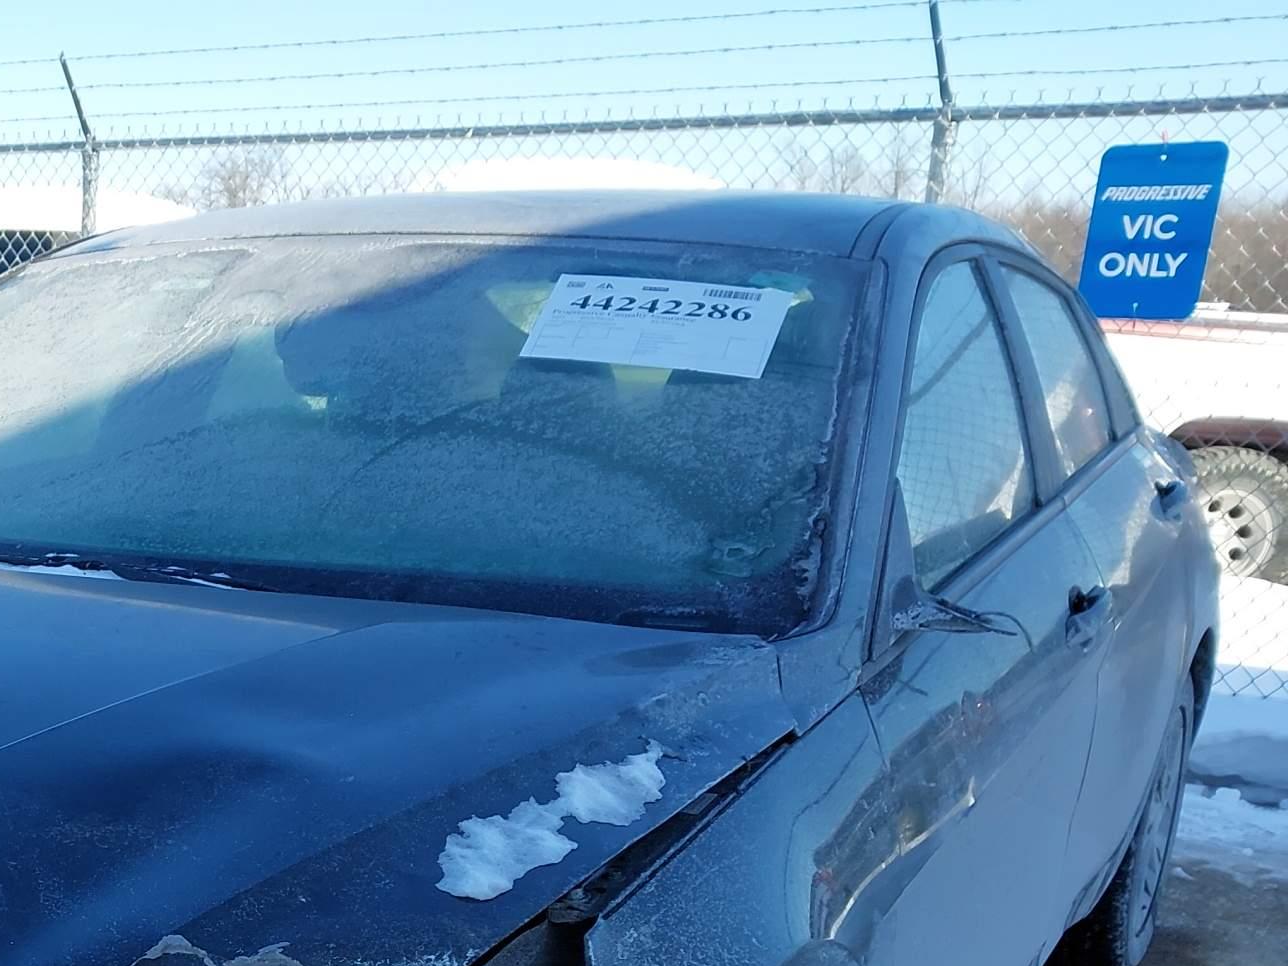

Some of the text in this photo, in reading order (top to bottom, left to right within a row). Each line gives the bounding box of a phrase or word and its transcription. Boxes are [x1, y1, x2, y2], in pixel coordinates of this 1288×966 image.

[1102, 184, 1213, 201] PROGRESSIVE
[1123, 214, 1179, 240] VIC
[1098, 252, 1188, 278] ONLY
[570, 294, 752, 322] 44242286
